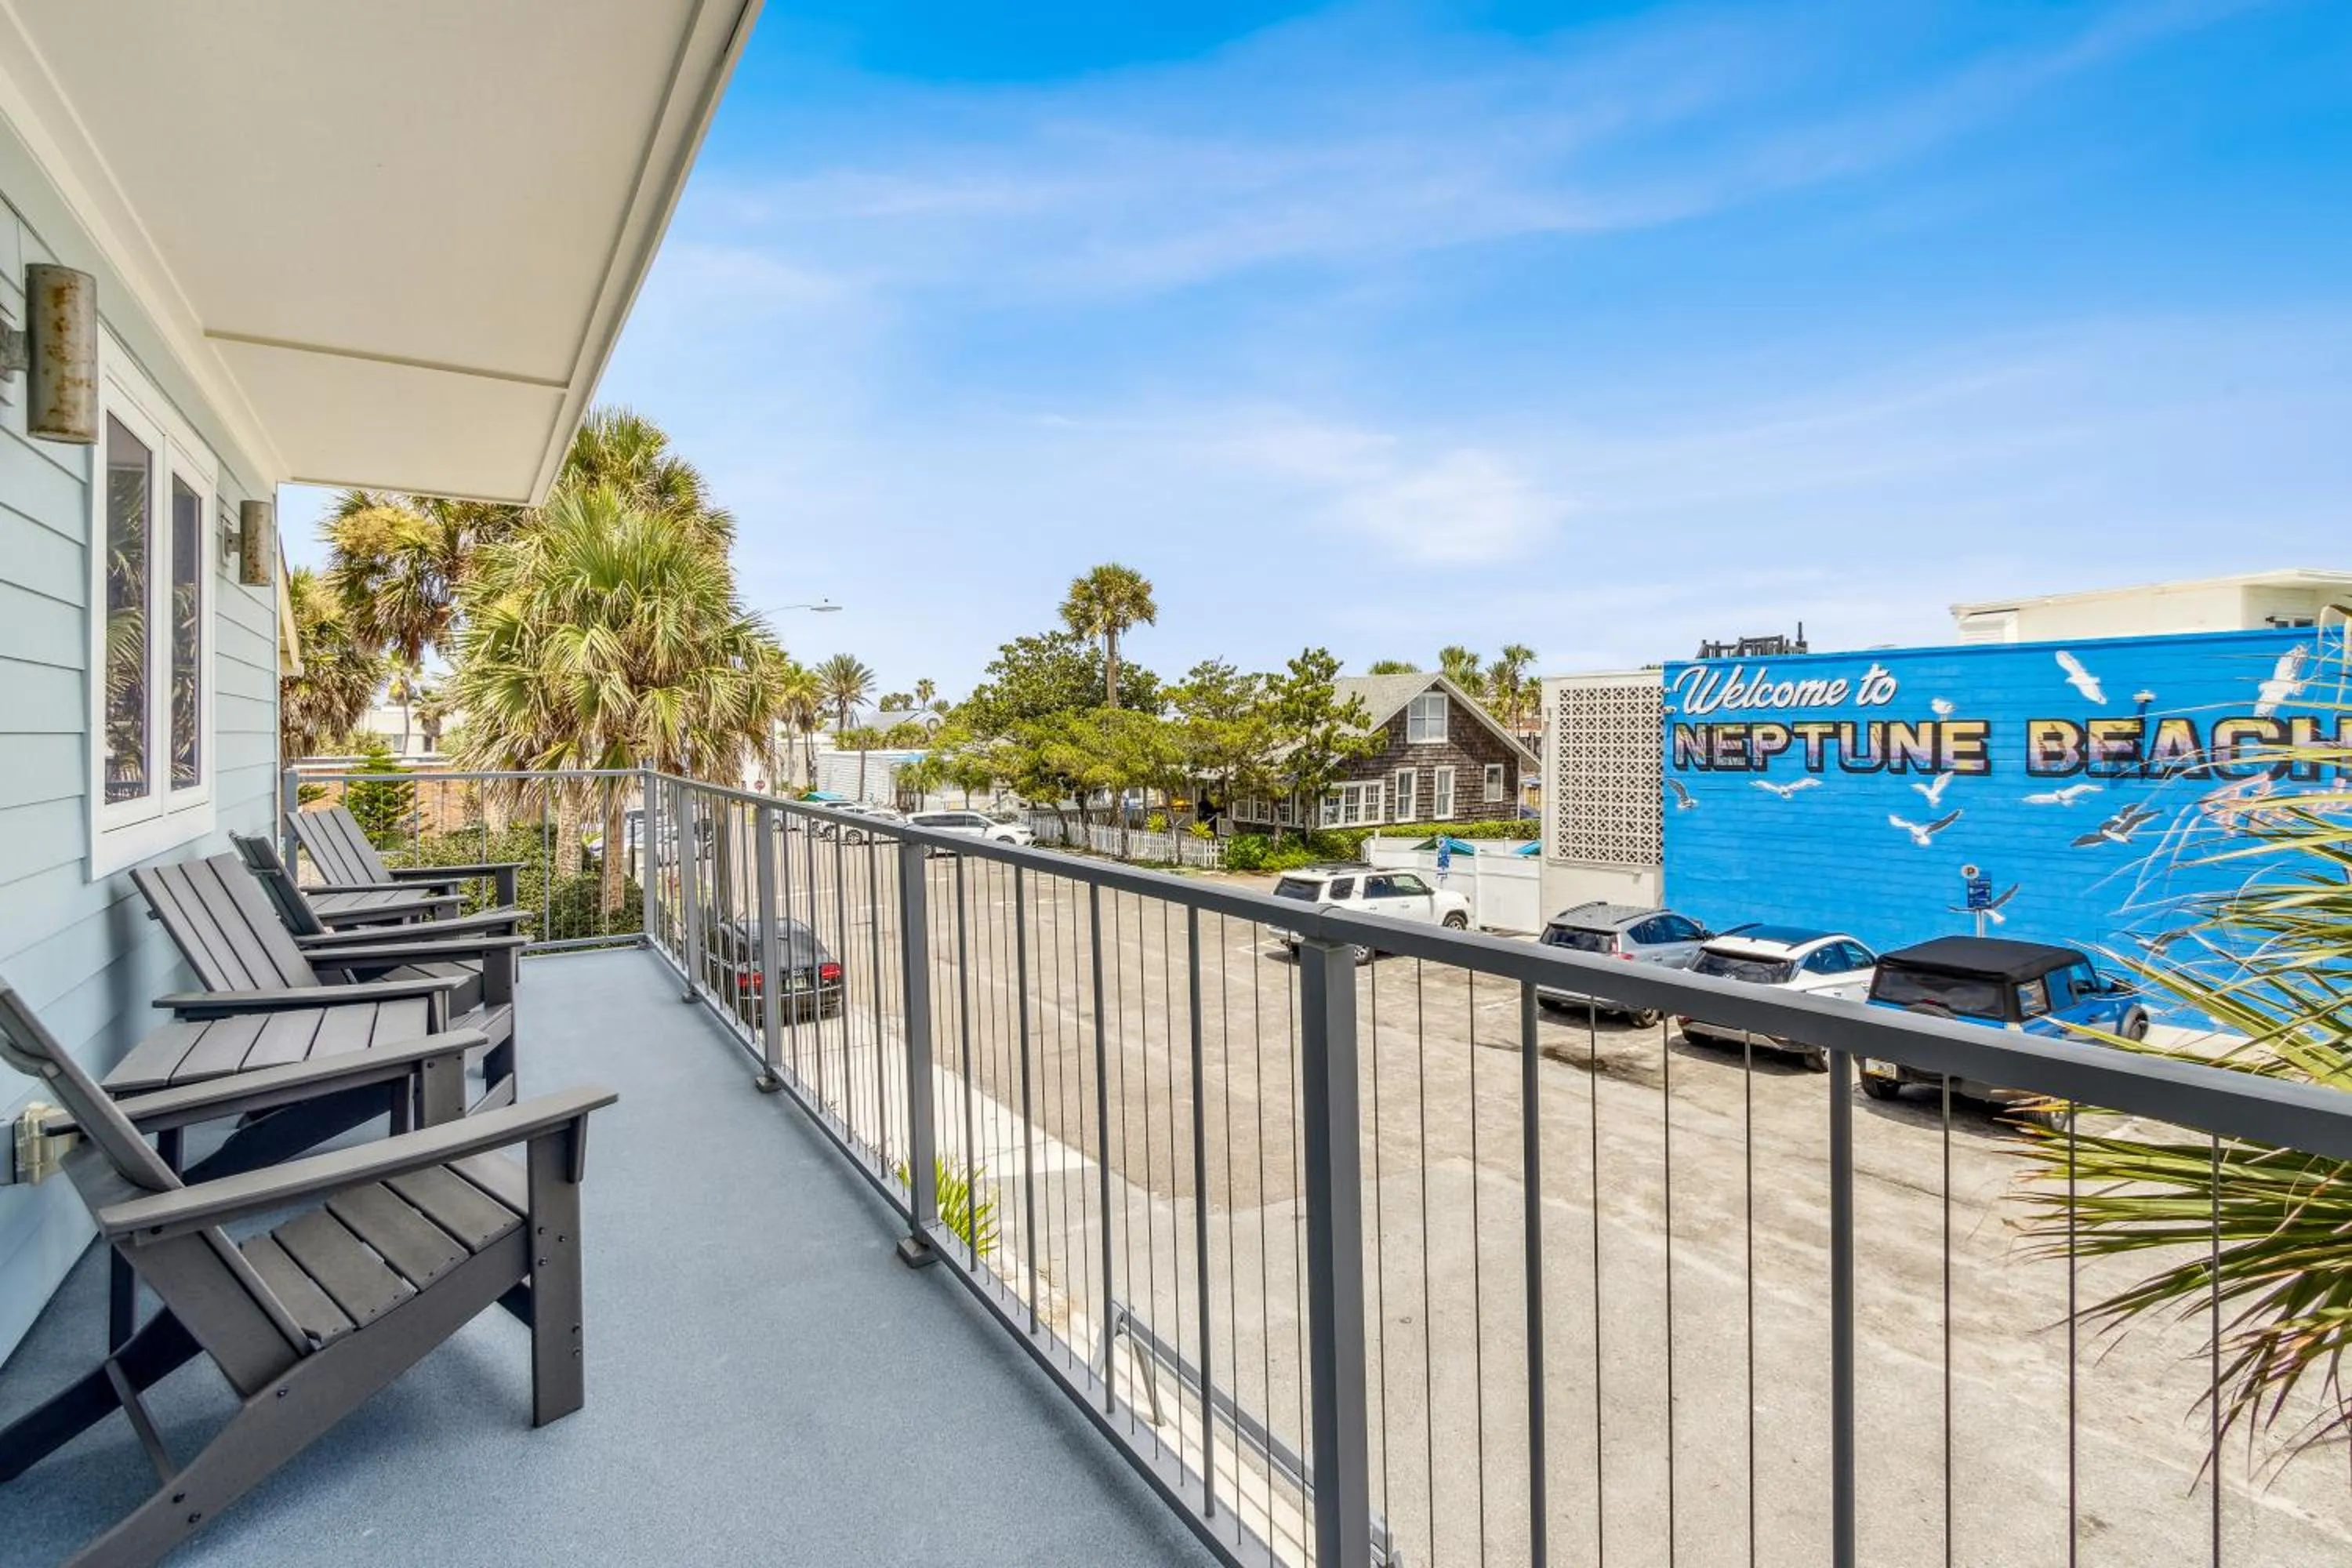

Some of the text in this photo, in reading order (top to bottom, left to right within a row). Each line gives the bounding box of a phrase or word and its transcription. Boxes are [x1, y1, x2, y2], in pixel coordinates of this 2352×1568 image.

[1673, 662, 1898, 715] Welcome to
[1672, 717, 2352, 782] NEPTUNE BEACH
